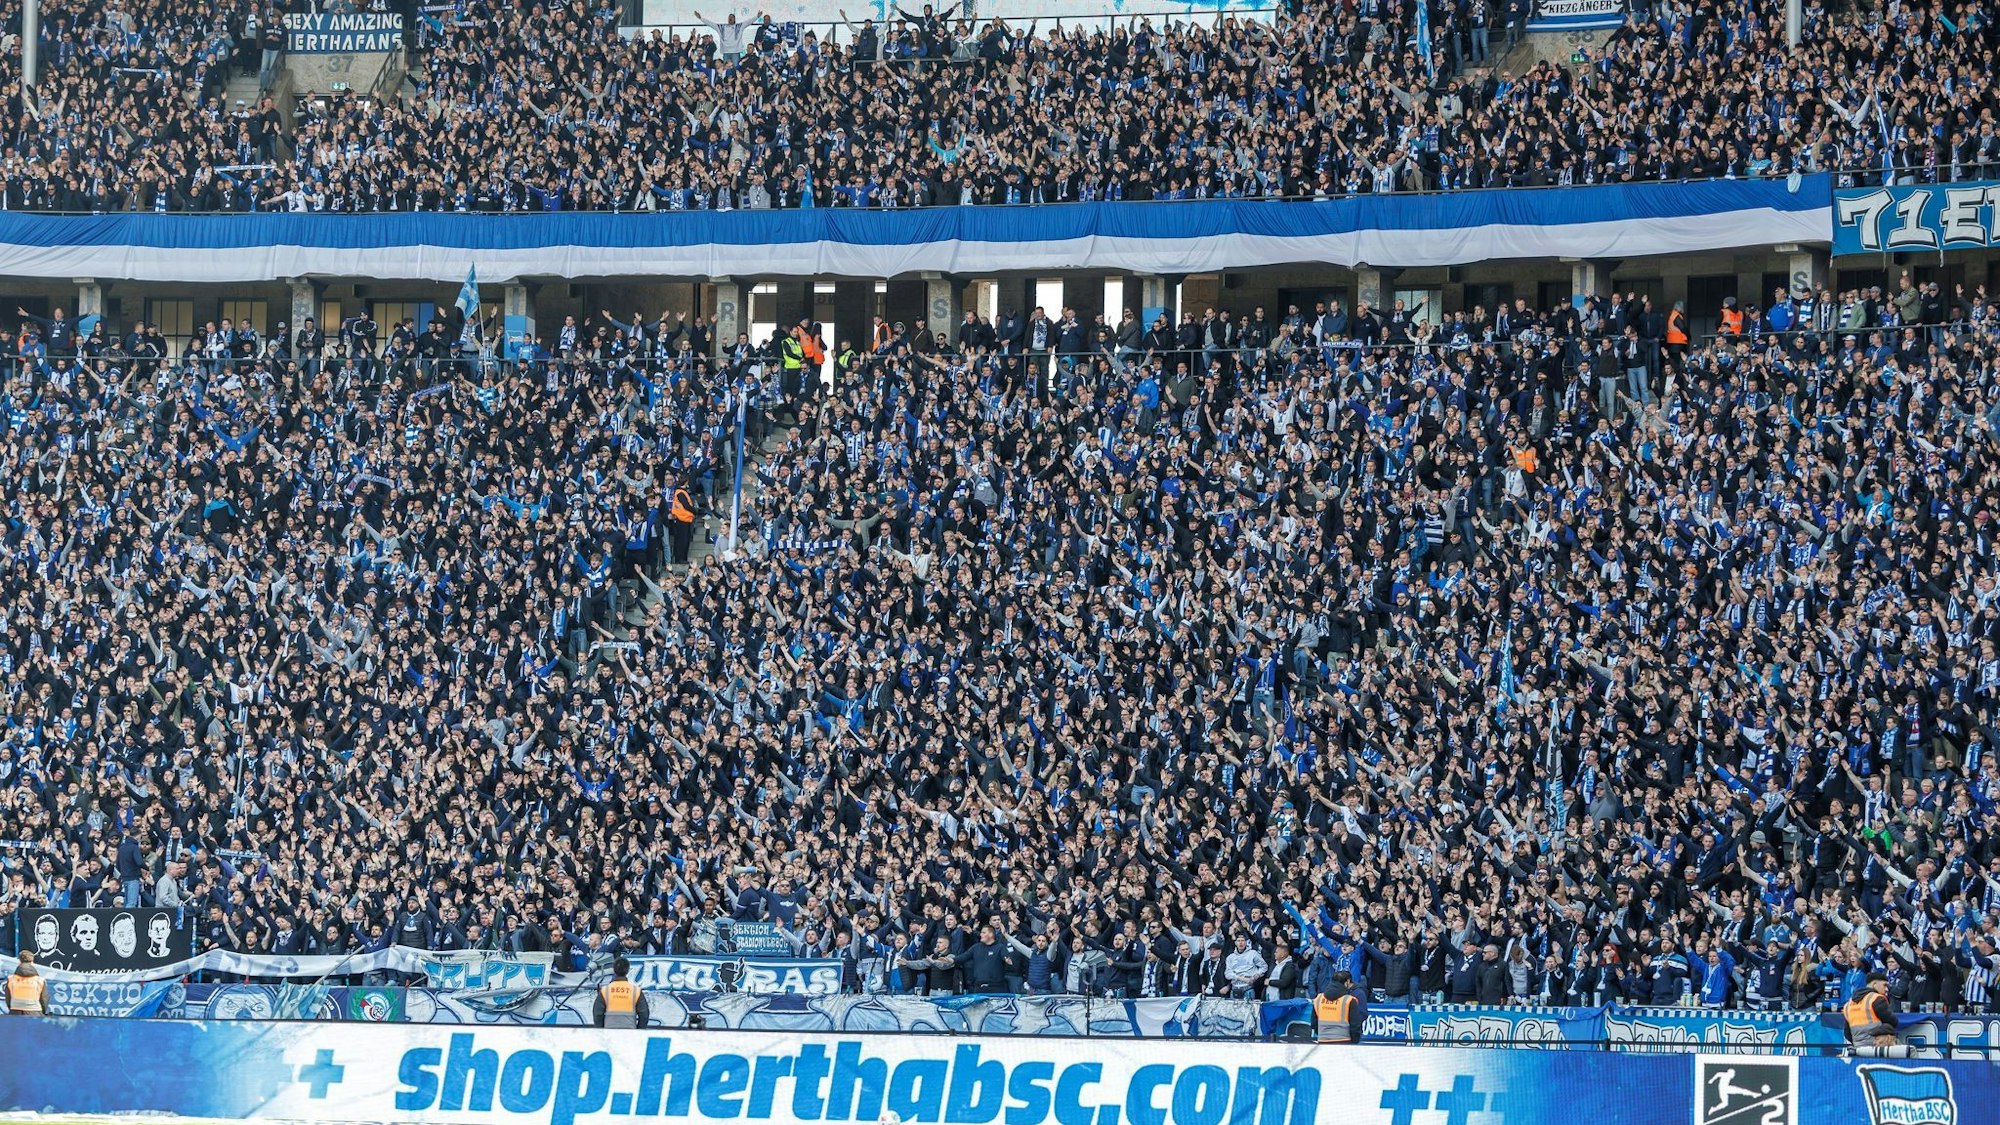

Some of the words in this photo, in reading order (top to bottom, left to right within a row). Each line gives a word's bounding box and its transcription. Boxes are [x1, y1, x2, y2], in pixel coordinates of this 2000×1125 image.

[1549, 0, 1612, 13] KIEZGÄNGER
[282, 13, 324, 30] SEXY
[329, 13, 403, 30] AMAZING
[328, 56, 354, 72] 37
[1793, 271, 1808, 292] S
[721, 302, 734, 321] R
[933, 299, 947, 318] S
[733, 924, 769, 935] SEKTION
[53, 983, 142, 1005] SEKTIO
[394, 1032, 1322, 1125] shop.herthabsc.com
